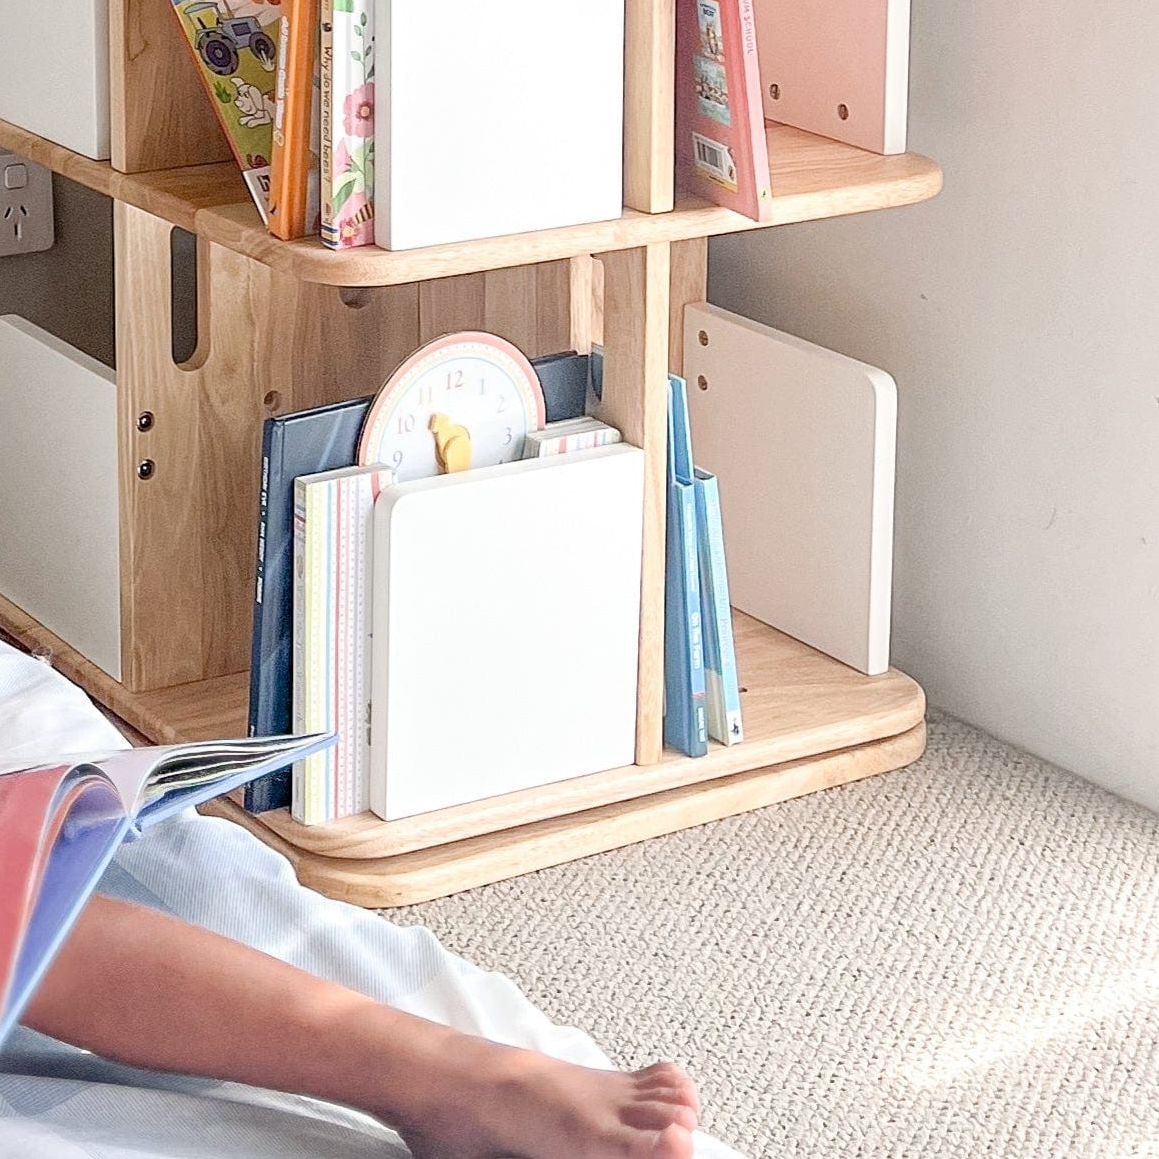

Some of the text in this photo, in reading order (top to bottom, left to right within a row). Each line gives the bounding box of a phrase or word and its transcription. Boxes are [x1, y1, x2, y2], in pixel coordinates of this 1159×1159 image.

[743, 16, 755, 55] SCHOOL
[321, 45, 333, 70] Why
[323, 73, 332, 89] do
[323, 90, 331, 108] we
[323, 110, 332, 142] need
[446, 370, 464, 391] 12
[479, 378, 486, 396] 1
[418, 386, 434, 406] 11
[497, 396, 506, 414] 2
[397, 414, 416, 435] 10
[503, 426, 513, 446] 3
[392, 450, 404, 474] 9
